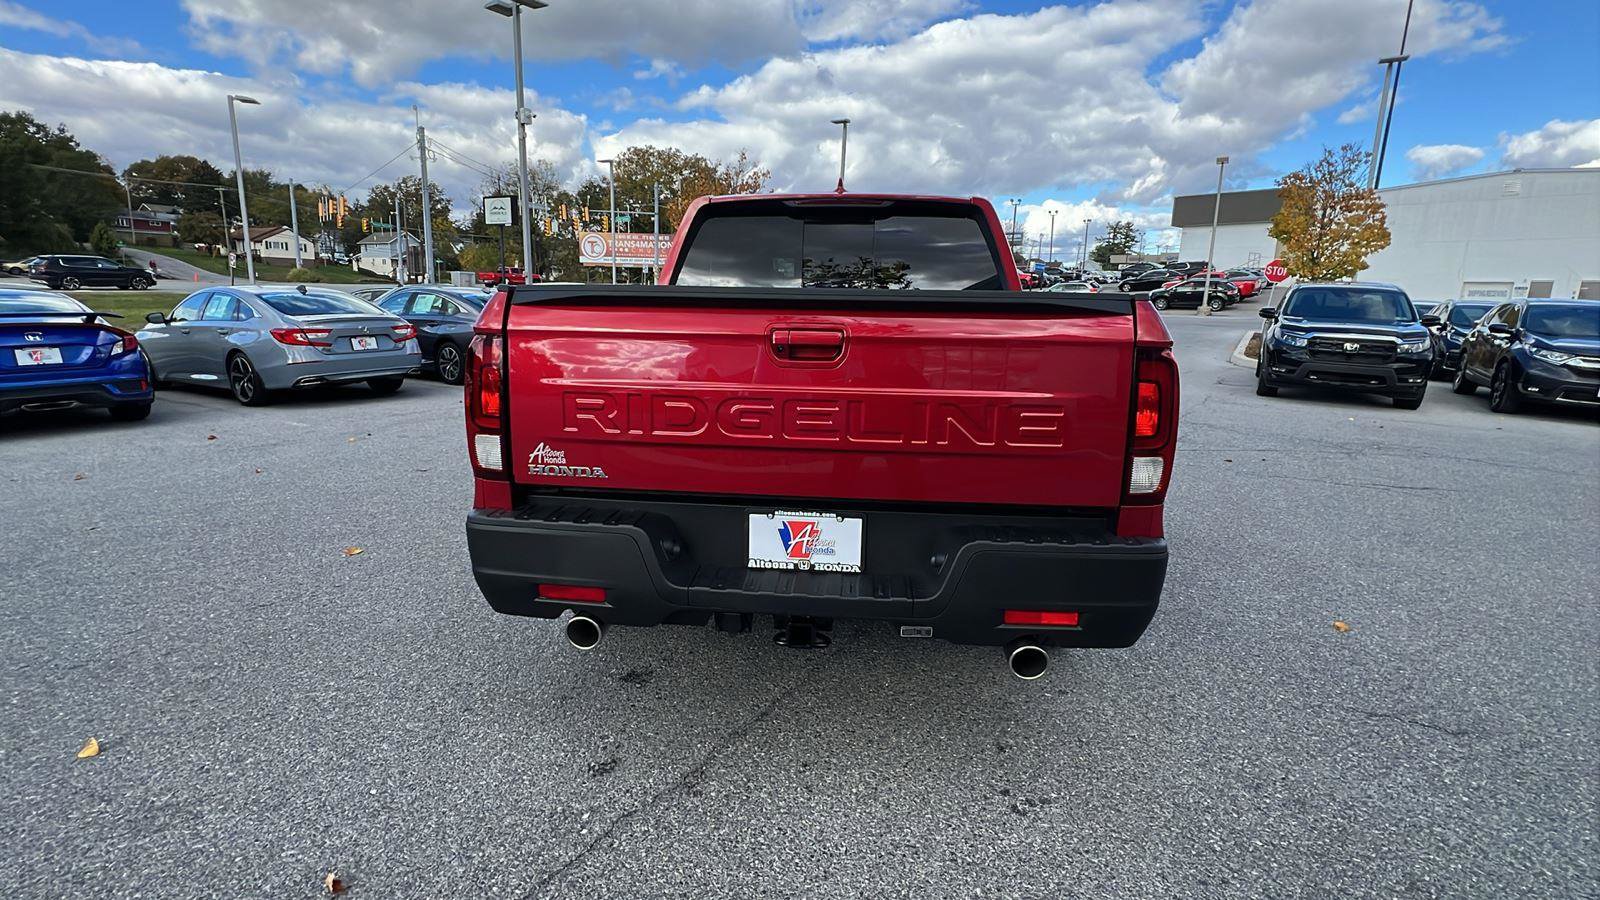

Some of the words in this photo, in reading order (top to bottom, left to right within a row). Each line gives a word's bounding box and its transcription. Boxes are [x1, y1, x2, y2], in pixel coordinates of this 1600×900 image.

[562, 390, 1065, 448] RIDGELINE
[528, 442, 565, 463] Altoona
[544, 456, 567, 464] Honda
[528, 464, 608, 478] HONDA
[805, 546, 834, 554] Honda
[748, 559, 794, 569] Altoona
[814, 562, 861, 573] HONDA
